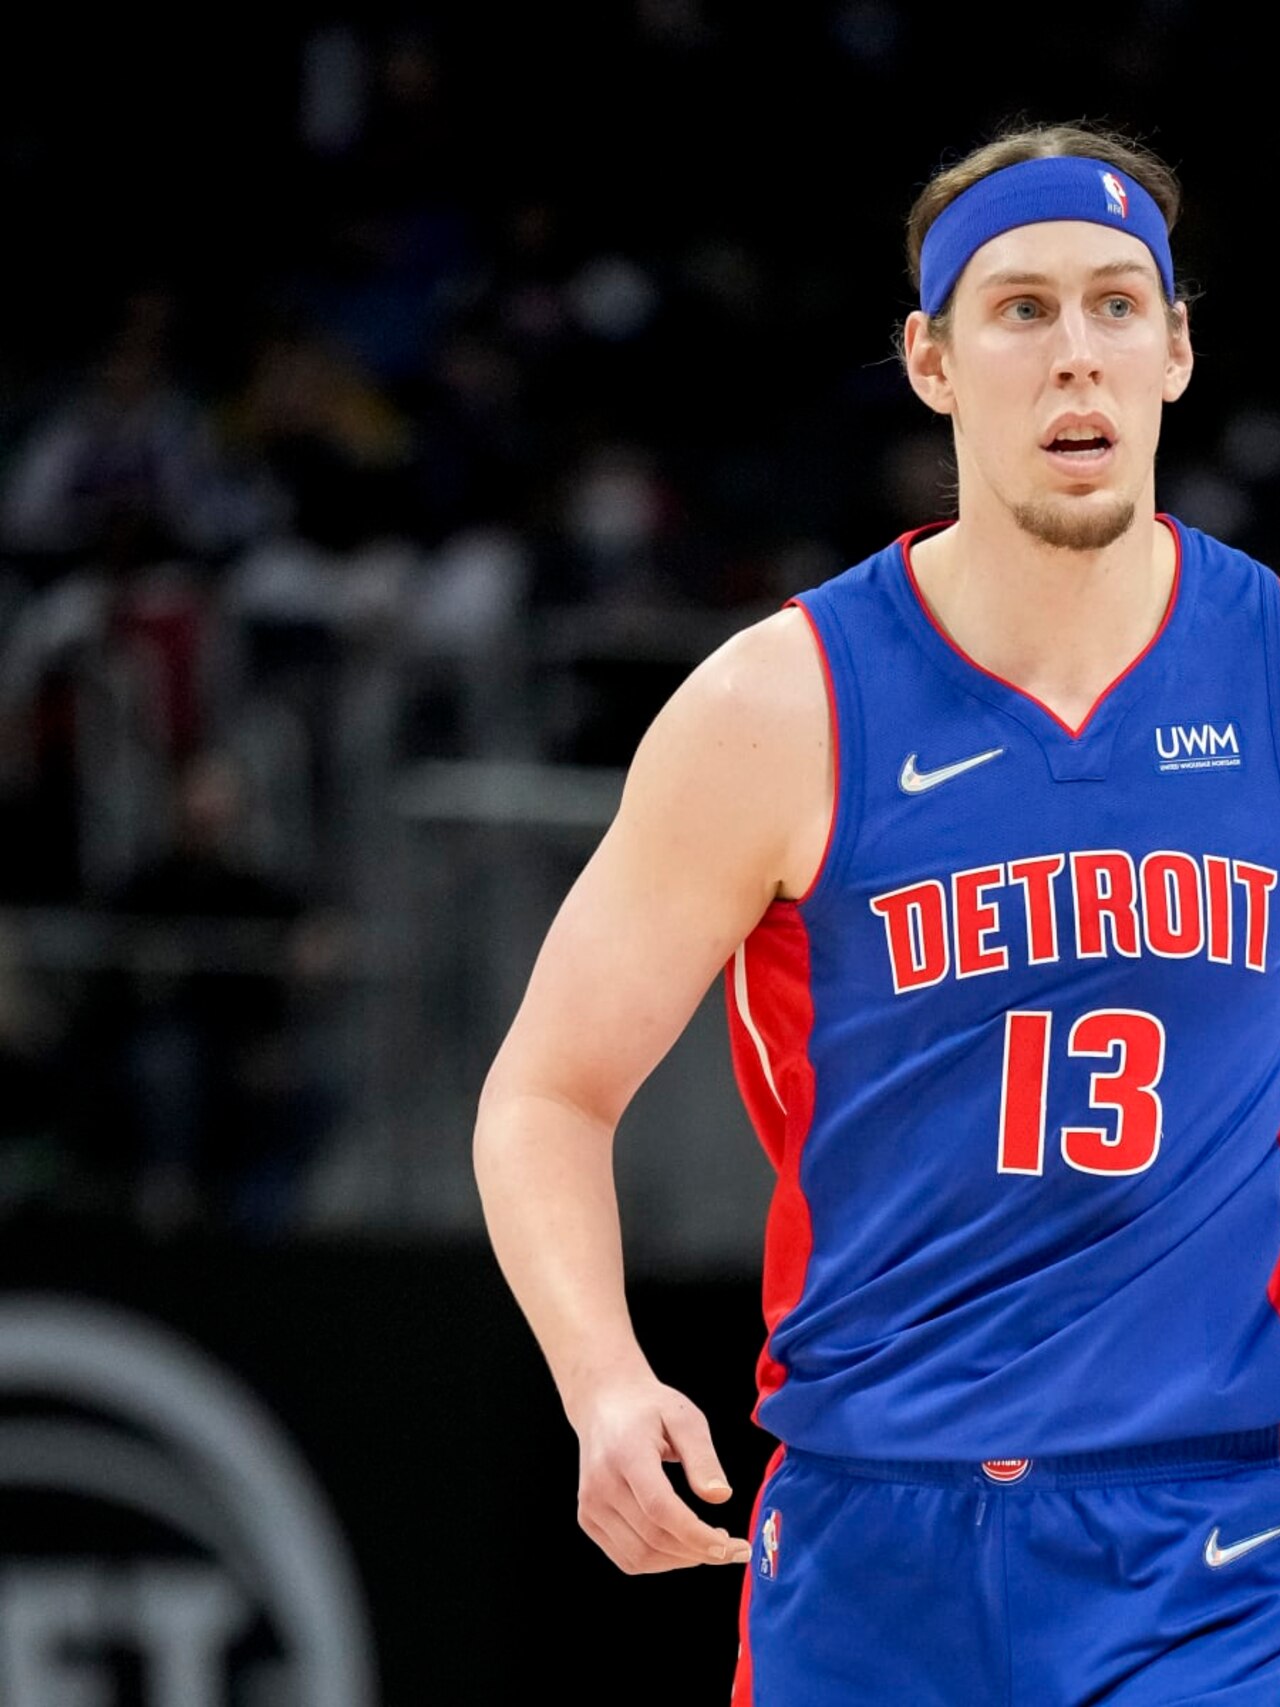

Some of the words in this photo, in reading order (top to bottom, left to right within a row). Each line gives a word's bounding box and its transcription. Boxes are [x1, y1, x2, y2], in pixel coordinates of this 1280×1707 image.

[1155, 723, 1240, 759] UWM
[869, 849, 1278, 995] DETROIT
[996, 1008, 1165, 1176] 13
